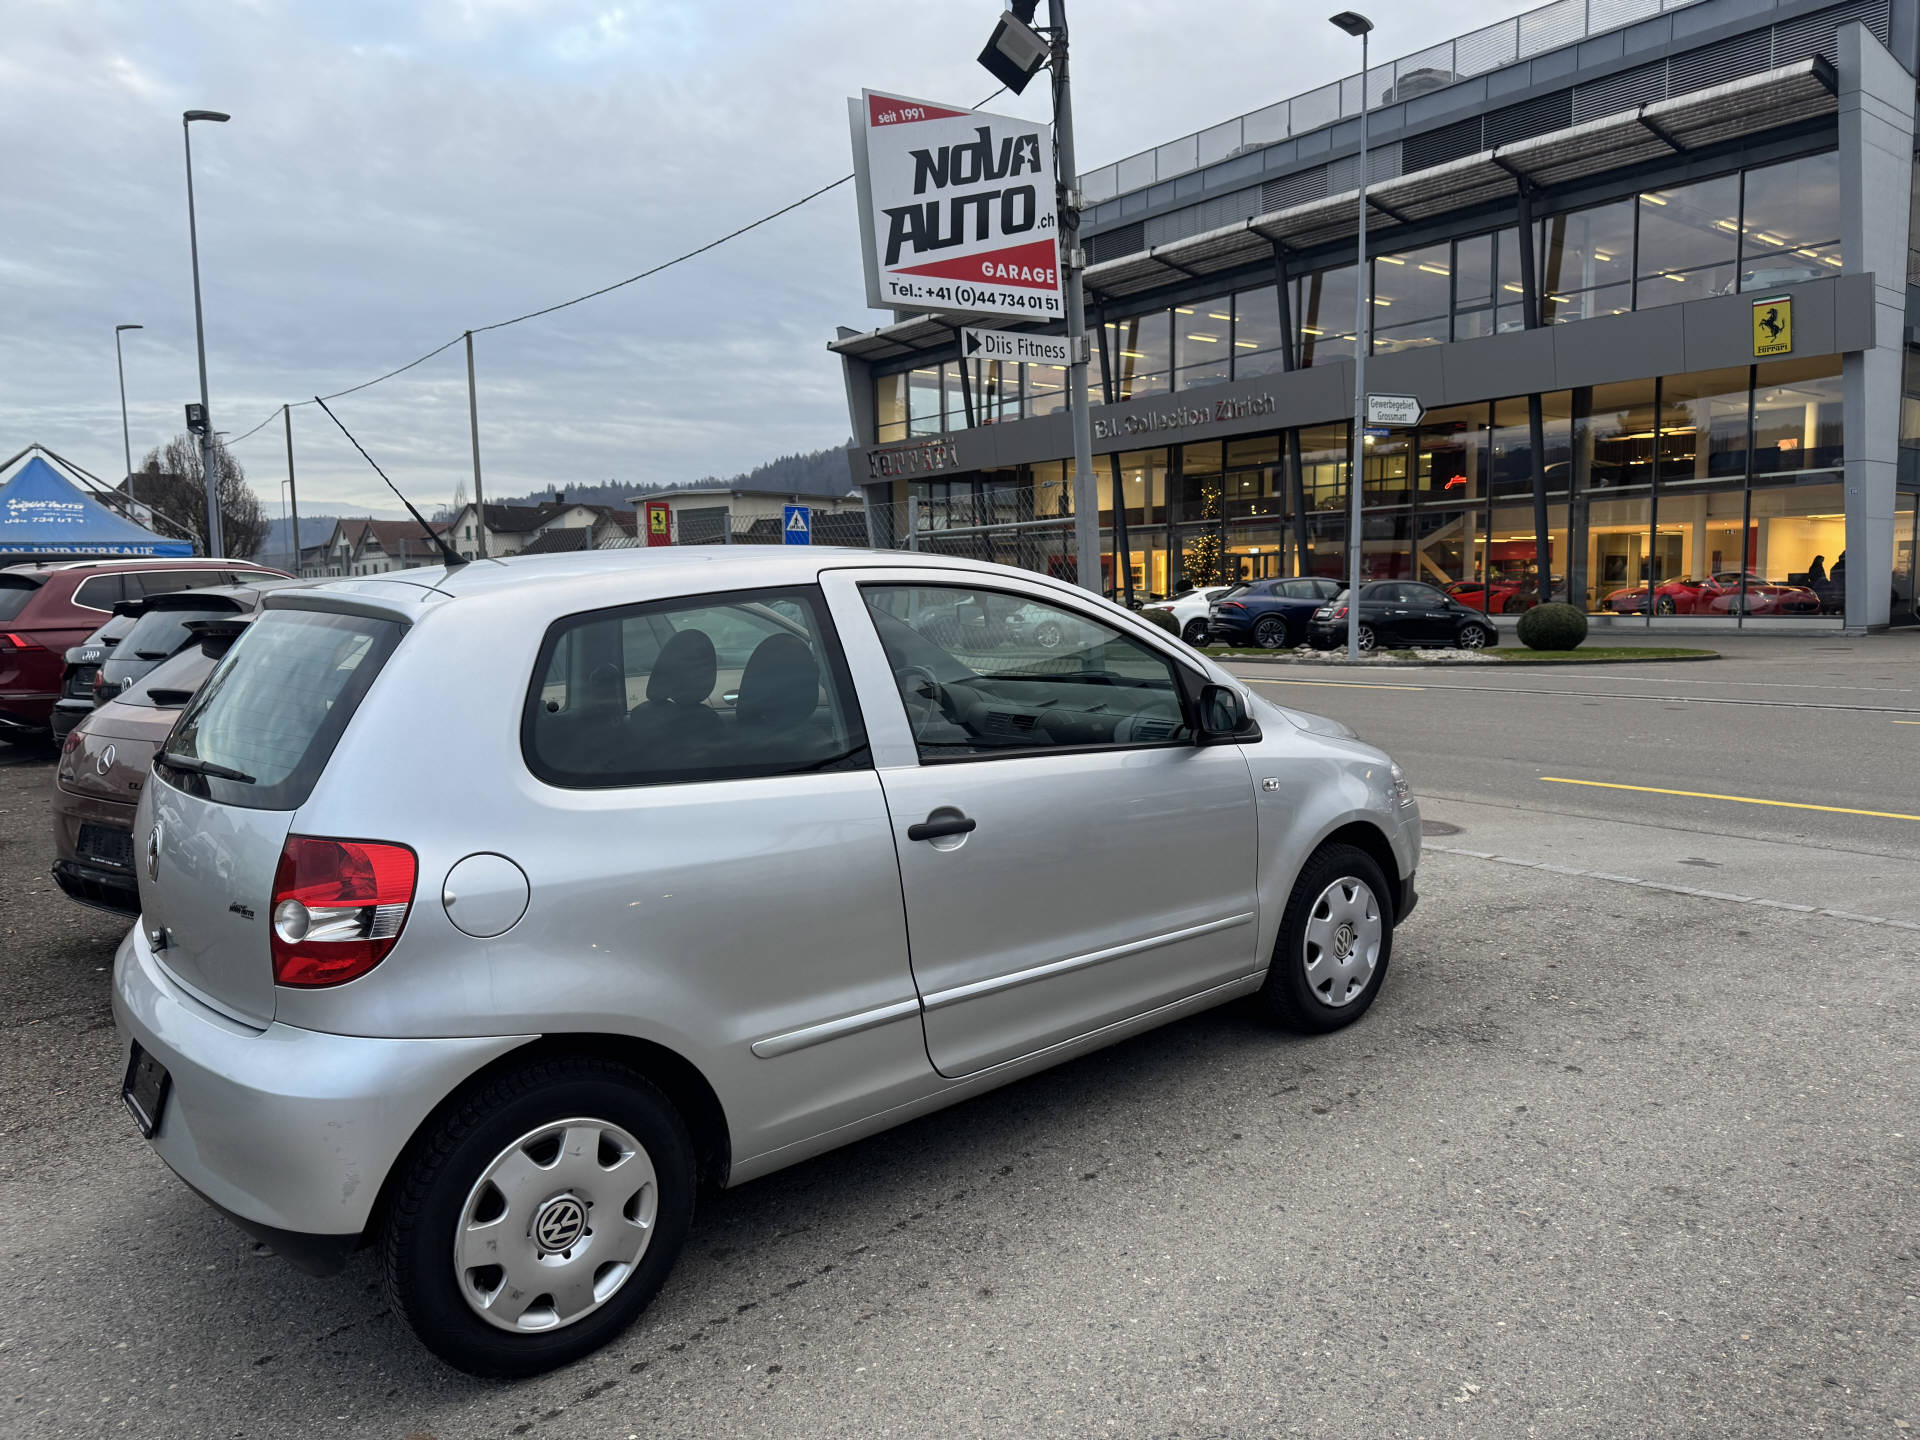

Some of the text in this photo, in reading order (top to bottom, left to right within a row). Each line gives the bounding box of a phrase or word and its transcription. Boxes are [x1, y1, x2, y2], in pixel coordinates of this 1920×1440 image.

[878, 107, 926, 124] seit 1991
[908, 126, 1042, 195] NOVA
[981, 262, 1055, 284] GARAGE
[889, 282, 1059, 311] Tel.: +41 (0)44 734 01 51
[985, 335, 1066, 360] Diis Fitness
[1125, 406, 1211, 434] Collection
[1216, 391, 1277, 421] Zürich
